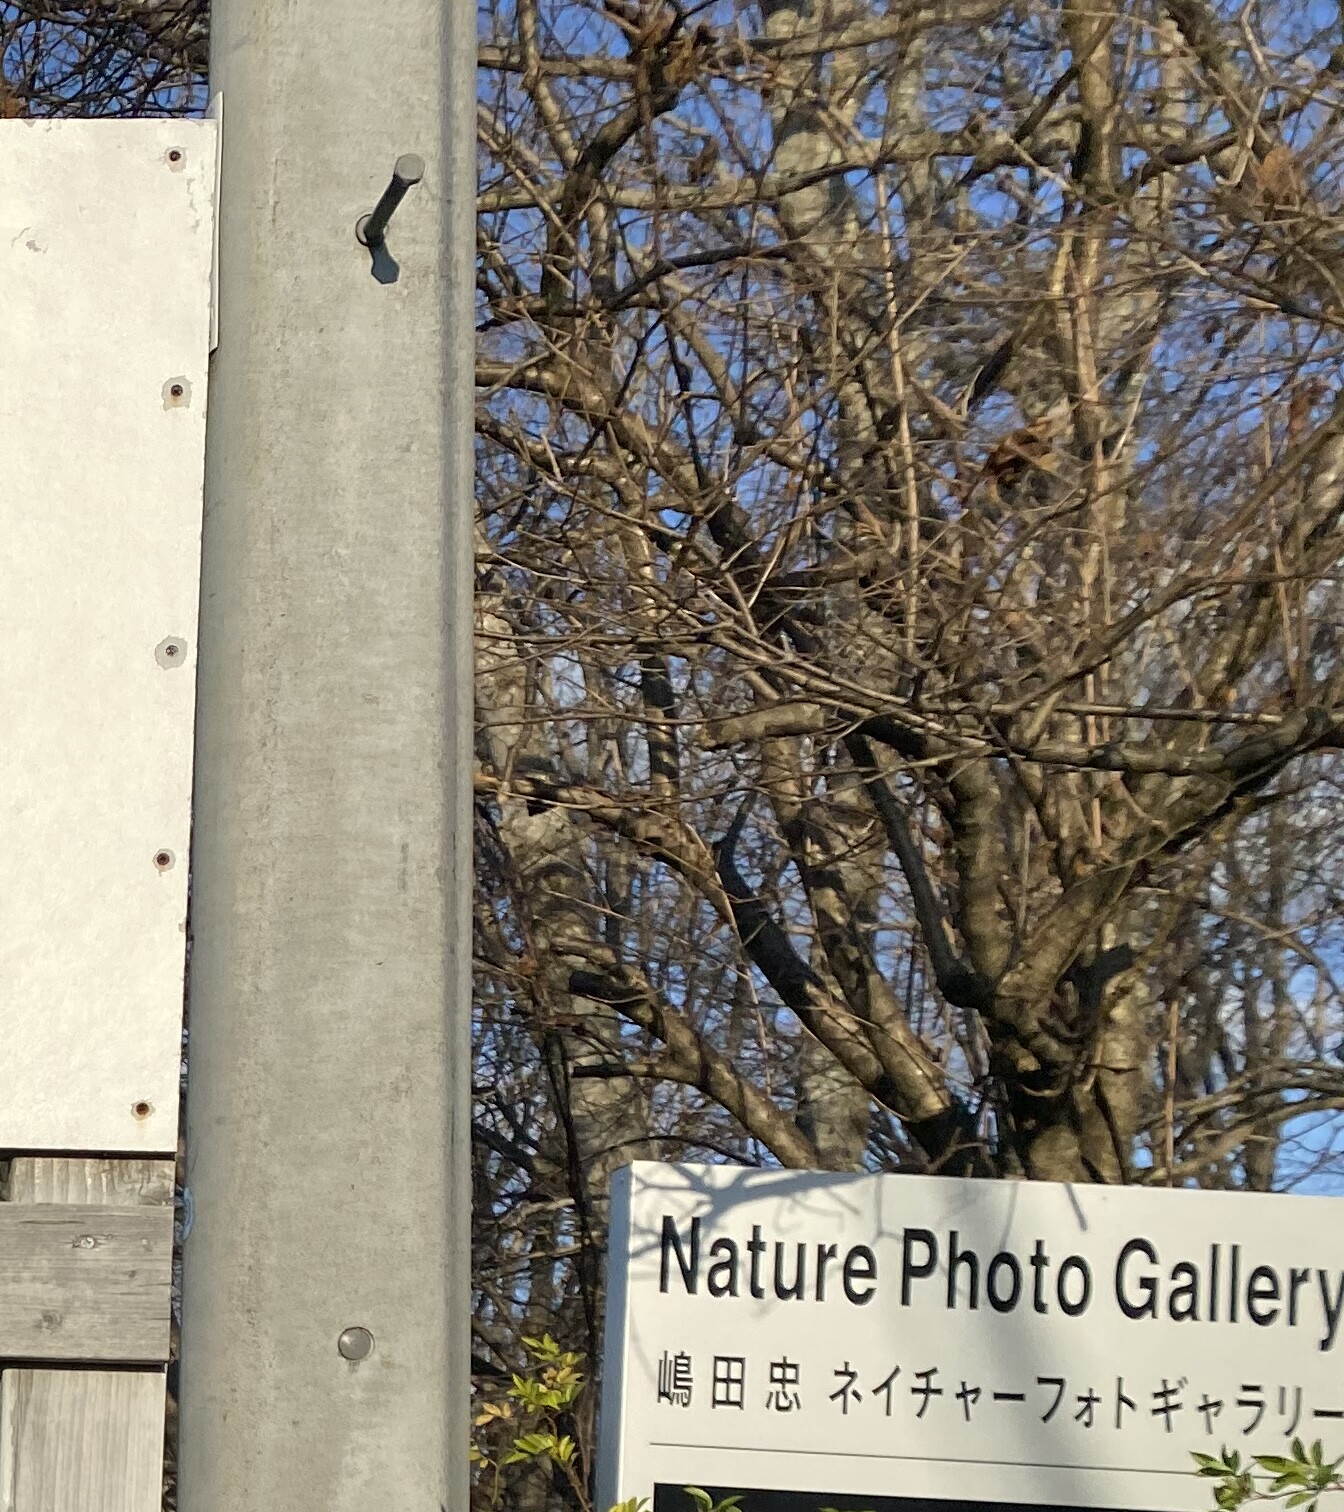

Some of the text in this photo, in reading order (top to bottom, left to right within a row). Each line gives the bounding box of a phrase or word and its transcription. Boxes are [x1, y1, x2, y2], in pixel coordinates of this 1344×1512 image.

[658, 1214, 1344, 1351] Nature Photo Gallery
[828, 1359, 1344, 1436] ネイチャーフォトギャラリー
